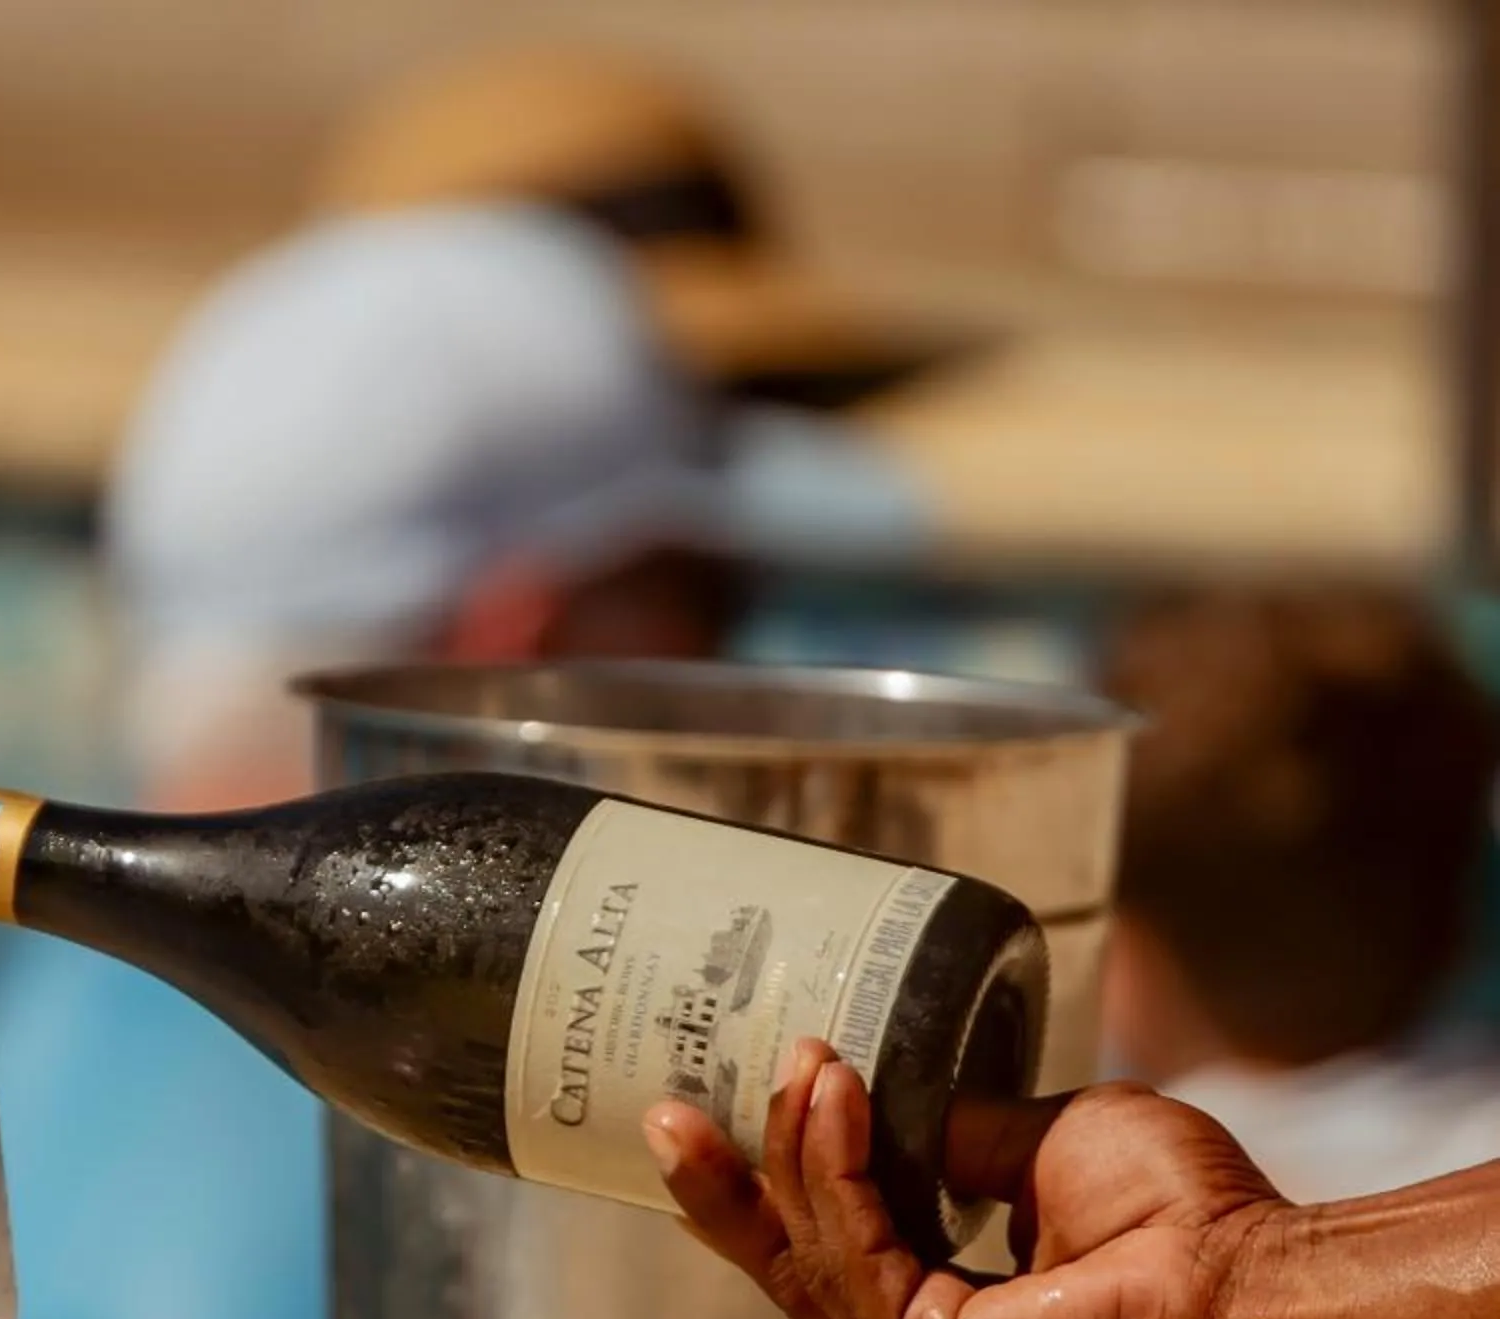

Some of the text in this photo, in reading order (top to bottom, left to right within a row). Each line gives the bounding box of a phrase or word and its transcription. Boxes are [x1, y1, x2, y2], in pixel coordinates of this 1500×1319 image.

[870, 917, 919, 961] PARA
[889, 899, 931, 919] LA
[550, 882, 640, 1127] CATENA ALTA
[623, 951, 662, 1080] CHARDONNAY
